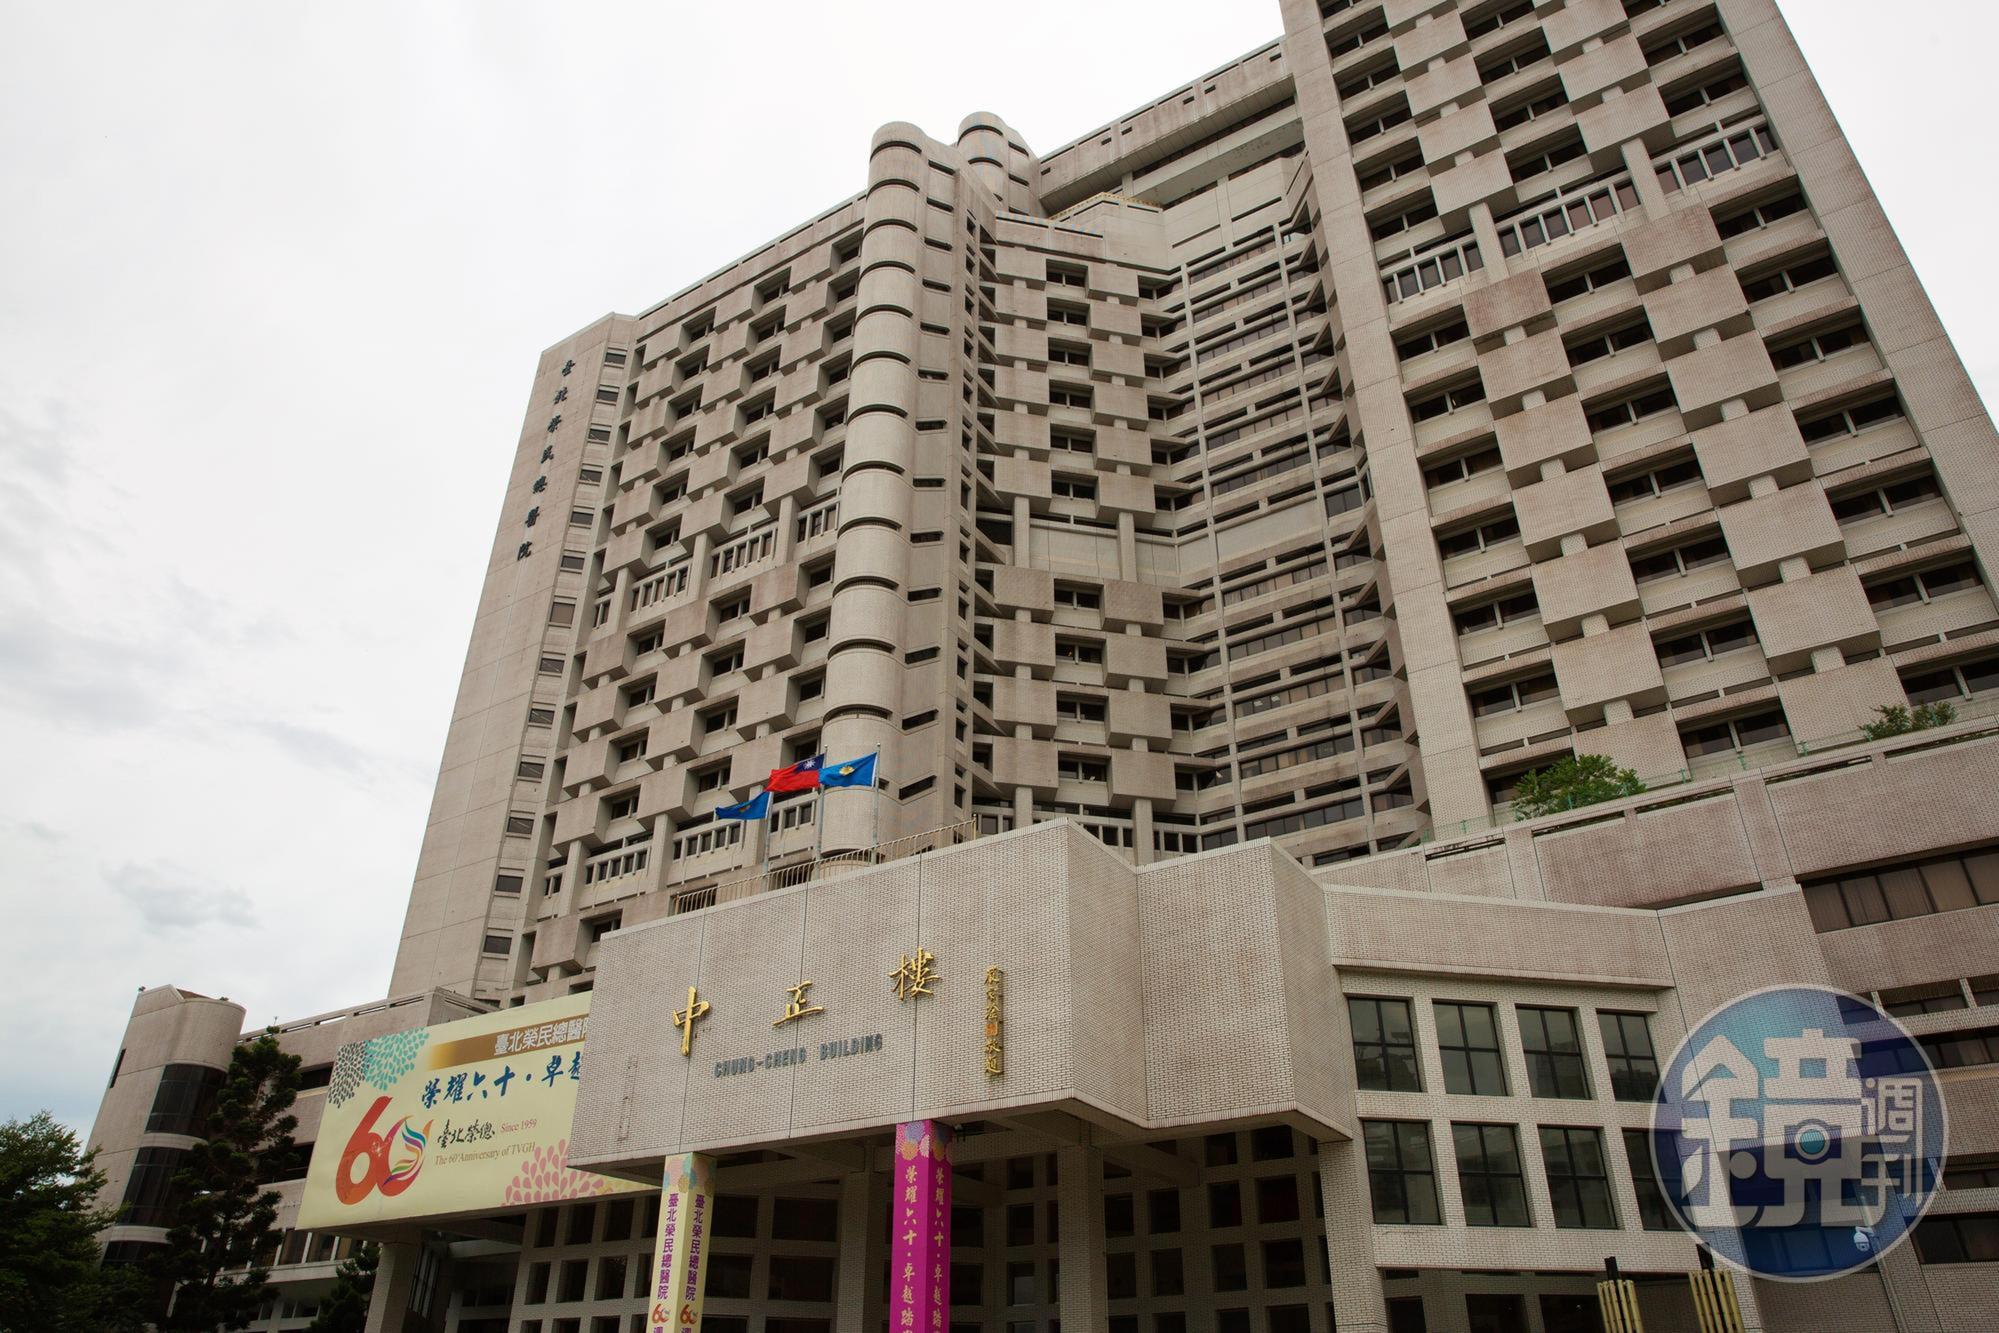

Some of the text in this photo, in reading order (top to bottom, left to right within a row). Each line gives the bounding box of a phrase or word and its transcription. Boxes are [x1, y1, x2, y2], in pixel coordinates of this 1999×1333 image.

[672, 945, 942, 1057] 中正樓
[713, 1032, 884, 1079] CHUNG-CHENG BUILDING
[437, 1118, 496, 1149] 臺北榮總
[500, 1118, 537, 1133] Since 1959
[435, 1156, 447, 1166] The
[458, 1149, 499, 1162] Anniversary
[501, 1145, 511, 1156] of
[511, 1142, 535, 1155] TVGH
